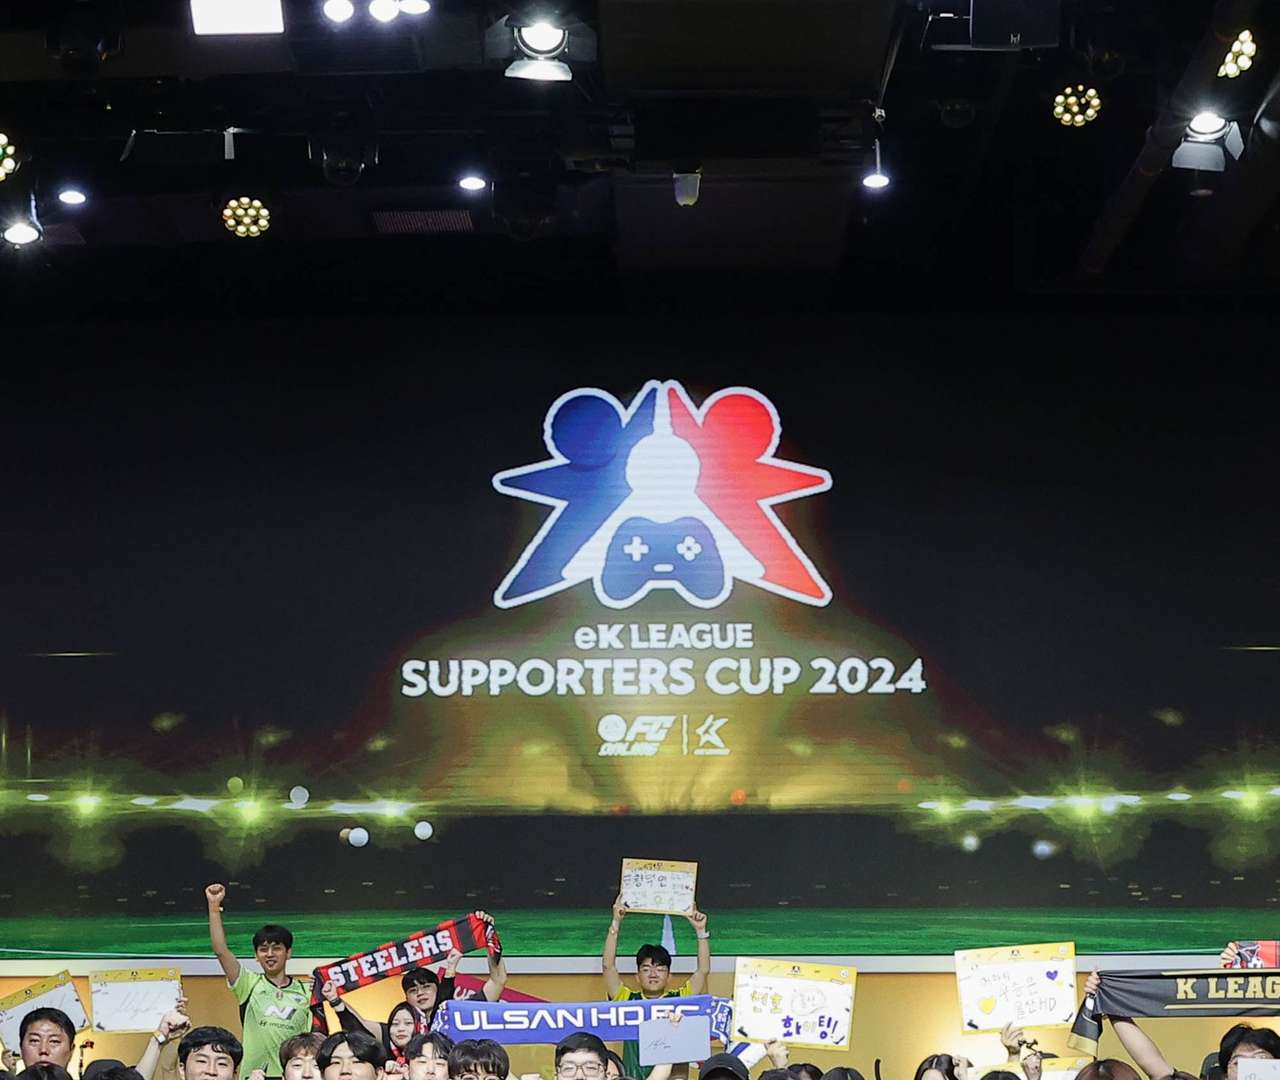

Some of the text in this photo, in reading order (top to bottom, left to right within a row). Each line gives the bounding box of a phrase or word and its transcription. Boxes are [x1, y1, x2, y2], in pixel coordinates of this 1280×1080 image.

[630, 623, 753, 649] LEAGUE
[401, 656, 926, 697] SUPPORTERS CUP 2024
[327, 930, 453, 988] STEELERS
[1175, 977, 1199, 1000] K
[453, 1007, 590, 1031] ULSAN
[592, 1005, 643, 1027] HD
